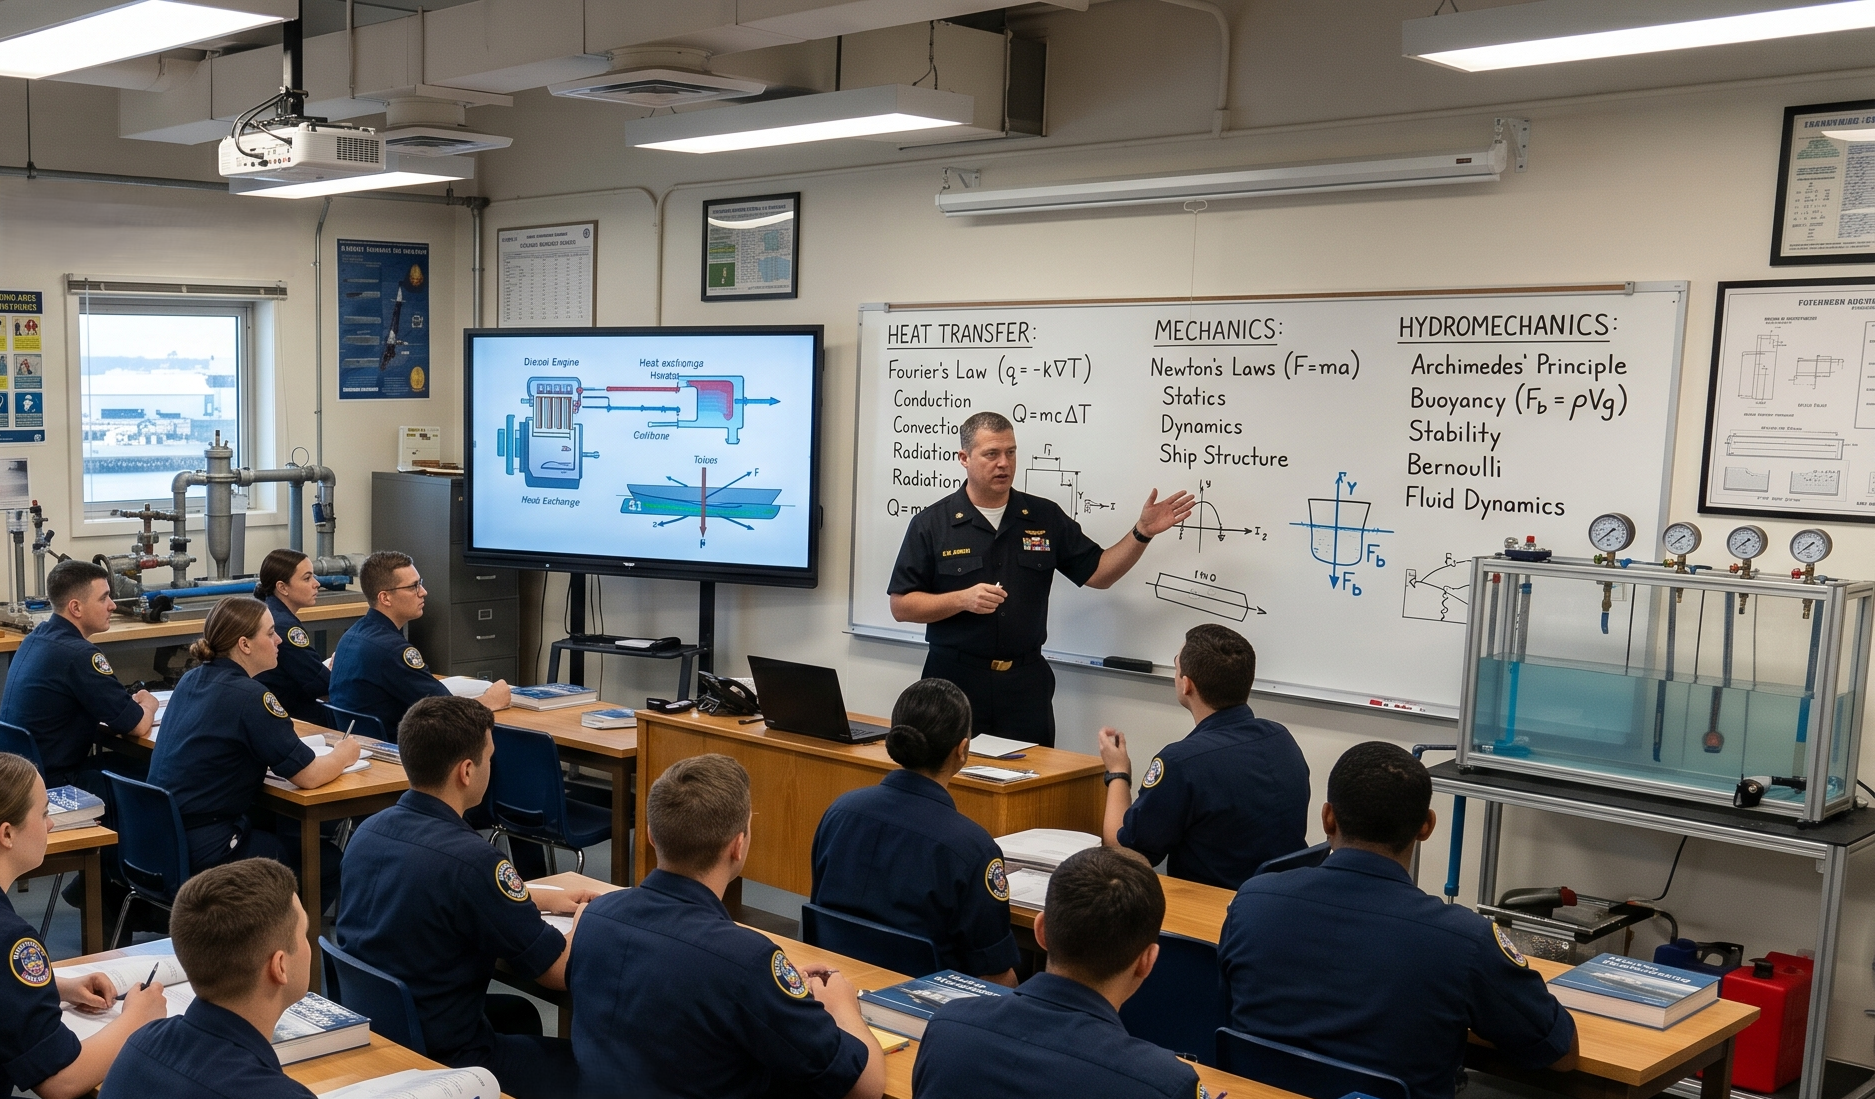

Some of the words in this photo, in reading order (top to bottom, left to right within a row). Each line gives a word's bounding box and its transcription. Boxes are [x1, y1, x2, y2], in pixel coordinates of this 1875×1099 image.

[888, 323, 932, 345] HEAT
[938, 321, 1037, 344] TRANSFER:
[1154, 317, 1283, 341] MECHANICS:
[1399, 313, 1618, 338] HYDROMECHANICS:
[639, 358, 660, 368] Heat
[888, 358, 949, 380] Fourier's
[956, 359, 988, 380] Law
[1150, 356, 1223, 377] Newton's
[1232, 356, 1276, 376] Laws
[1284, 349, 1360, 380] (F=ma)
[1411, 353, 1527, 375] Archimedes'
[1536, 353, 1628, 382] Principle
[893, 389, 972, 409] Conduction
[1162, 385, 1226, 406] Statics
[1410, 386, 1507, 417] Buoyancy
[893, 415, 959, 436] Convectio
[1160, 413, 1243, 441] Dynamics
[1408, 419, 1502, 452] Stability
[1159, 443, 1198, 470] Ship
[1203, 445, 1289, 468] Structure
[1407, 452, 1502, 478] Bernoulli
[892, 468, 961, 489] Radiation
[886, 498, 928, 518] Q=m
[1405, 485, 1454, 509] Fluid
[1464, 488, 1566, 521] Dynamics
